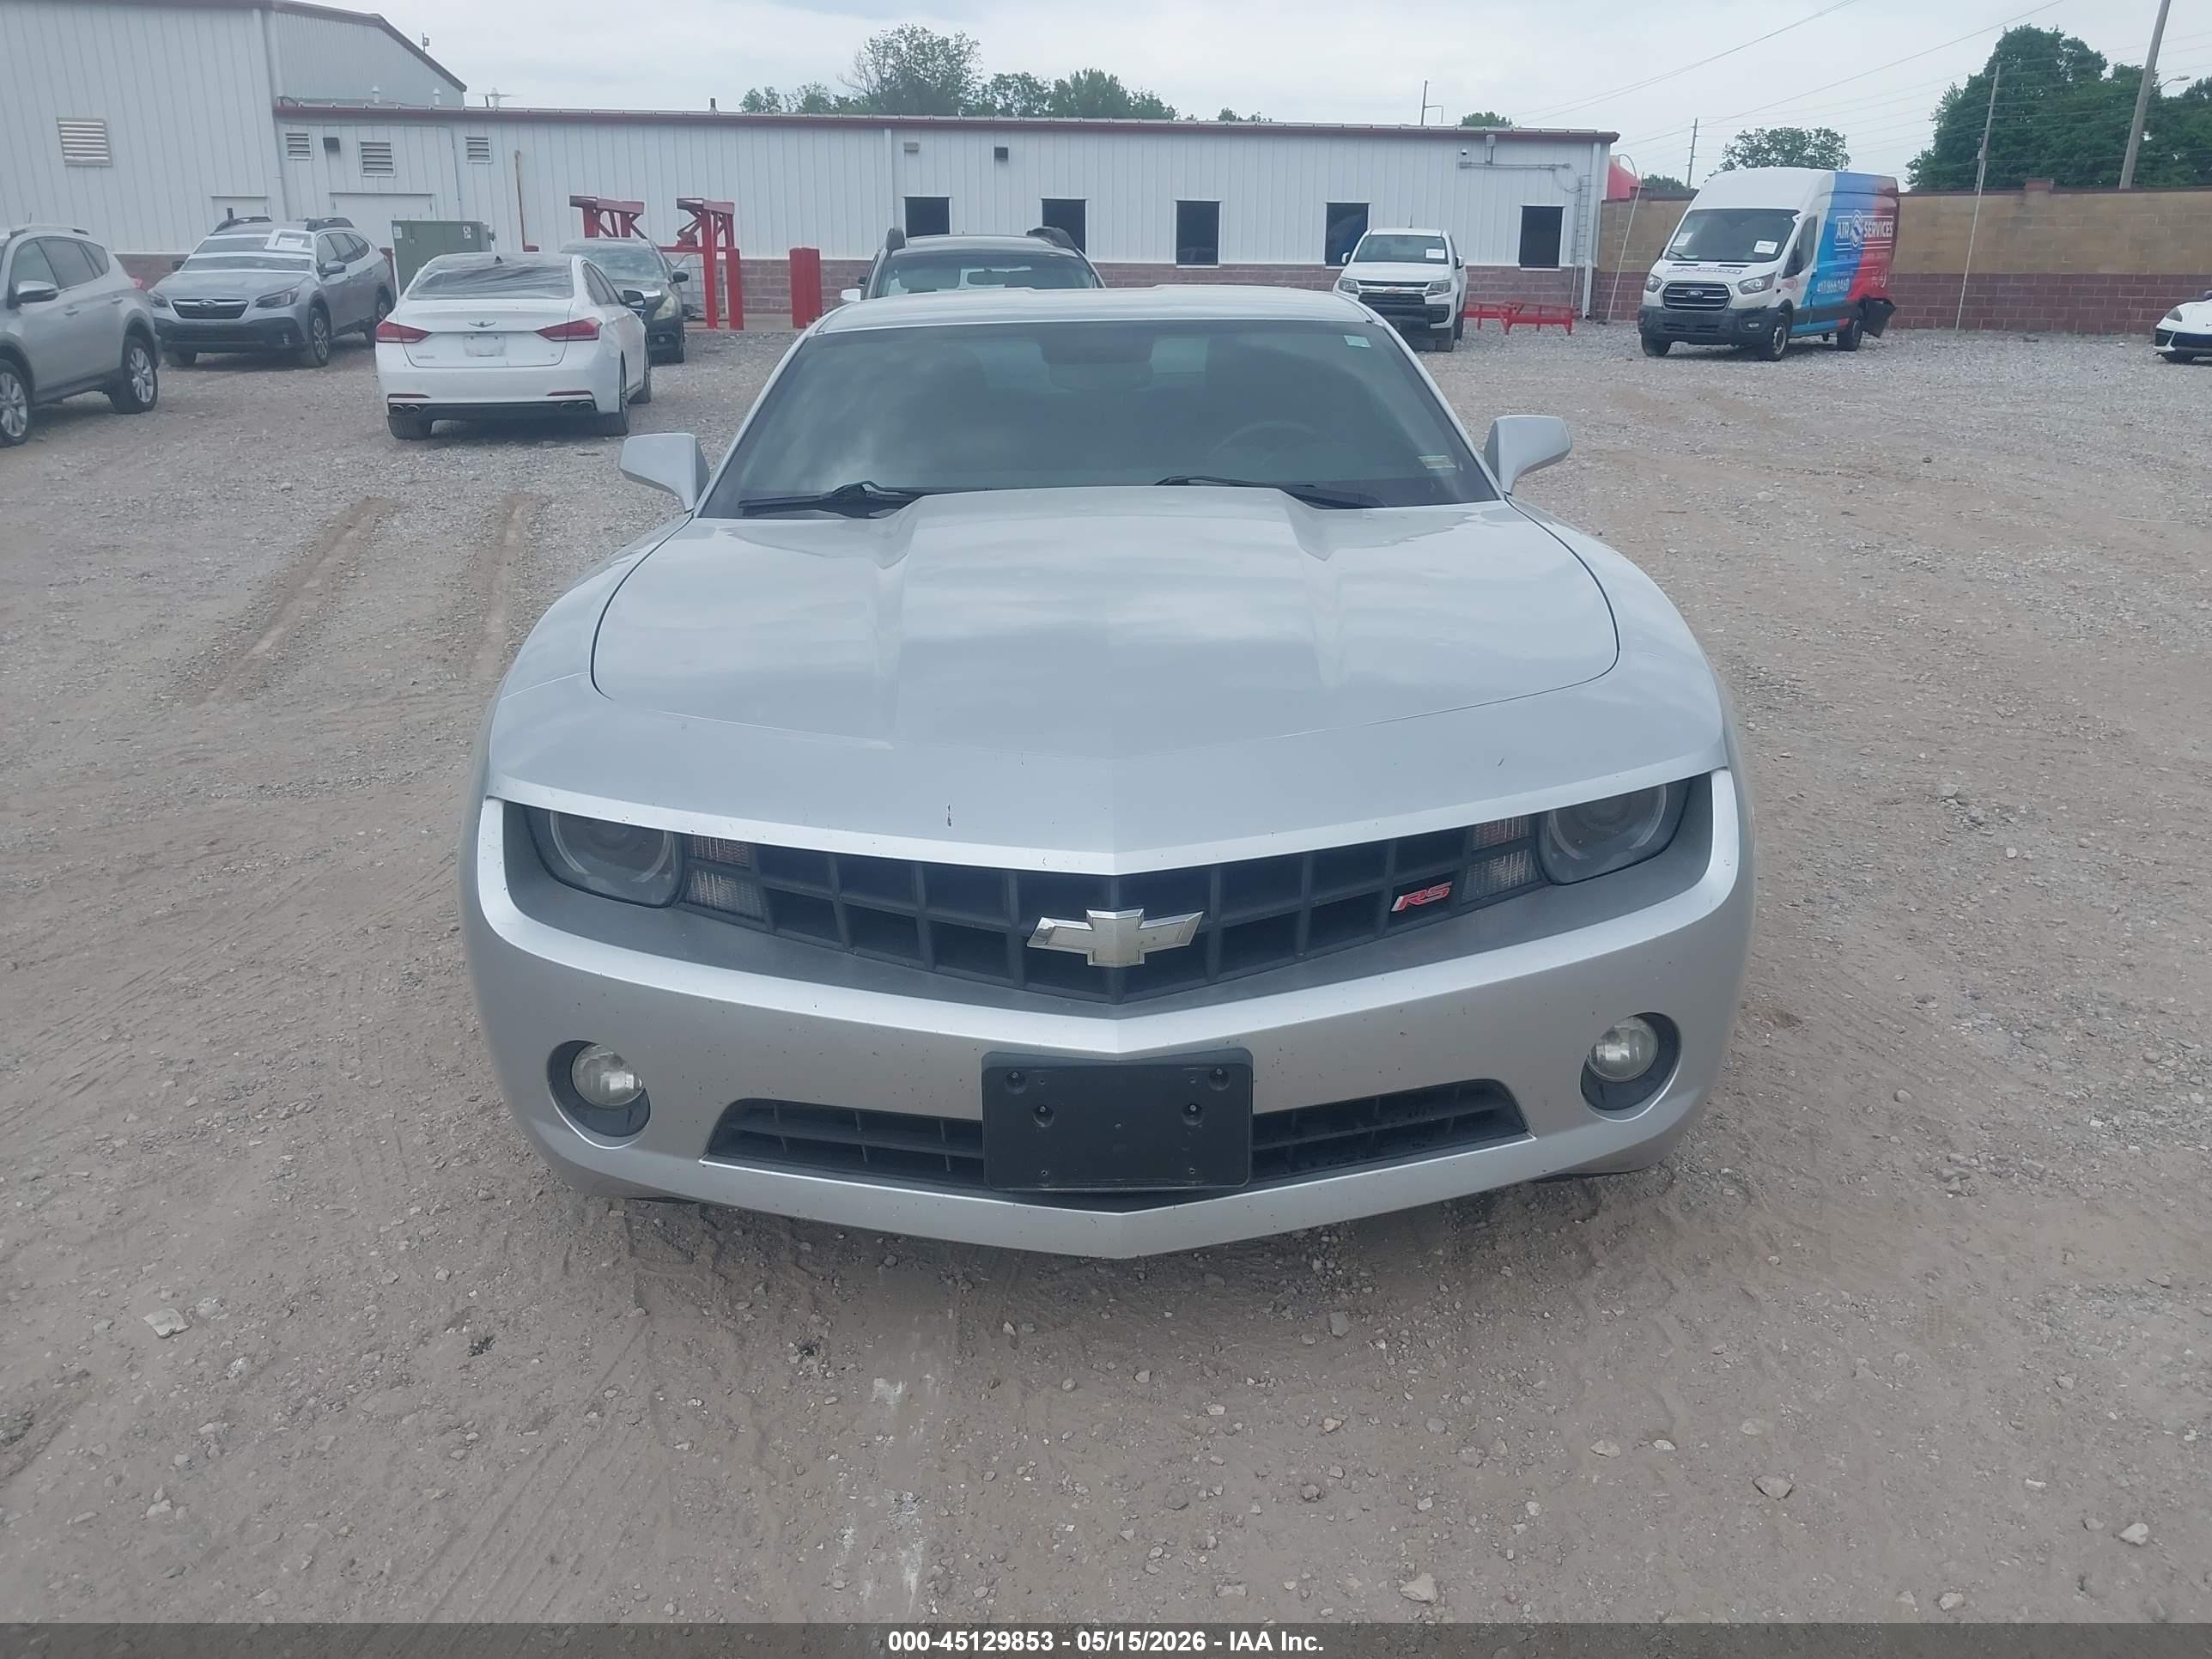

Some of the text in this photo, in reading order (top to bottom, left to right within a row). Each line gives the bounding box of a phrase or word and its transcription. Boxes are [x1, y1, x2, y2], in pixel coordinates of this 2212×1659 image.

[1836, 221, 1893, 240] AIR SERVICES
[1391, 881, 1453, 912] RS
